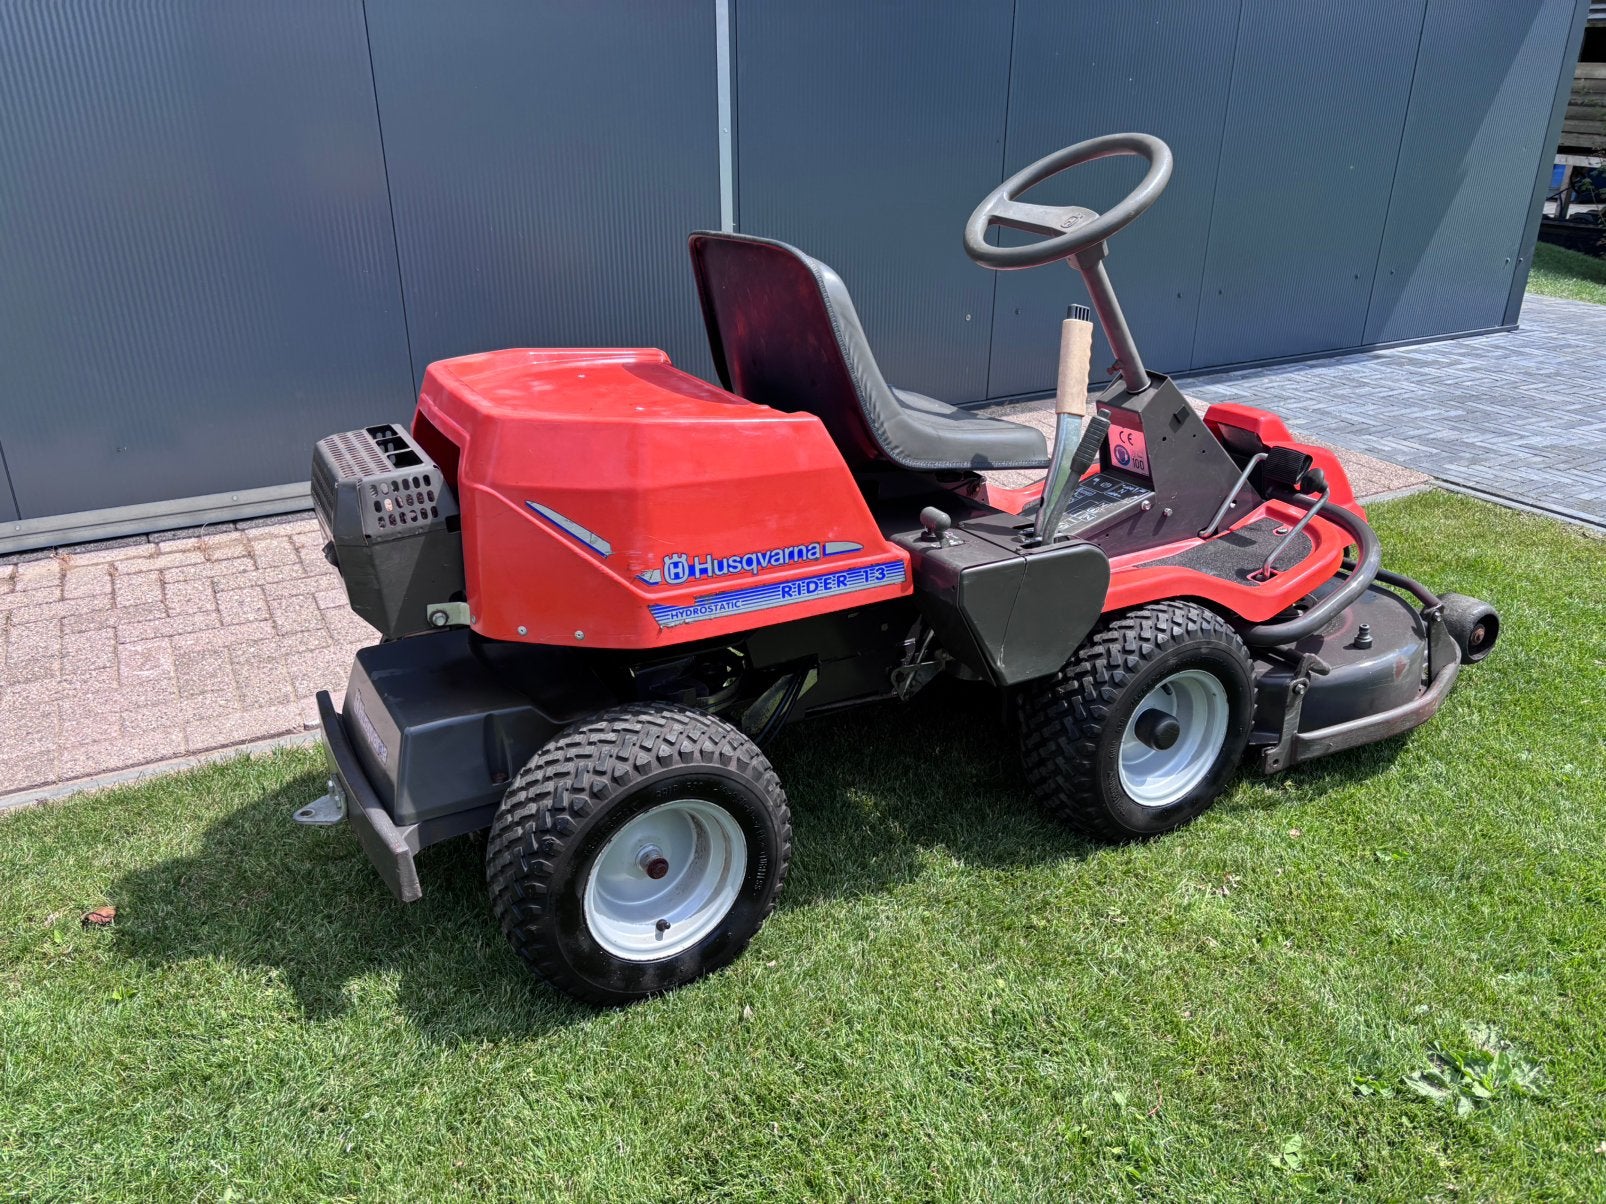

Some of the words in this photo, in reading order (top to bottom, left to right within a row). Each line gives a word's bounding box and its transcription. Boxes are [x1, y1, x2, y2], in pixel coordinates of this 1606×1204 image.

[694, 542, 820, 579] Husqvarna
[781, 574, 848, 599] RIDER
[863, 566, 886, 583] 13
[670, 601, 741, 620] HYDROSTATIC
